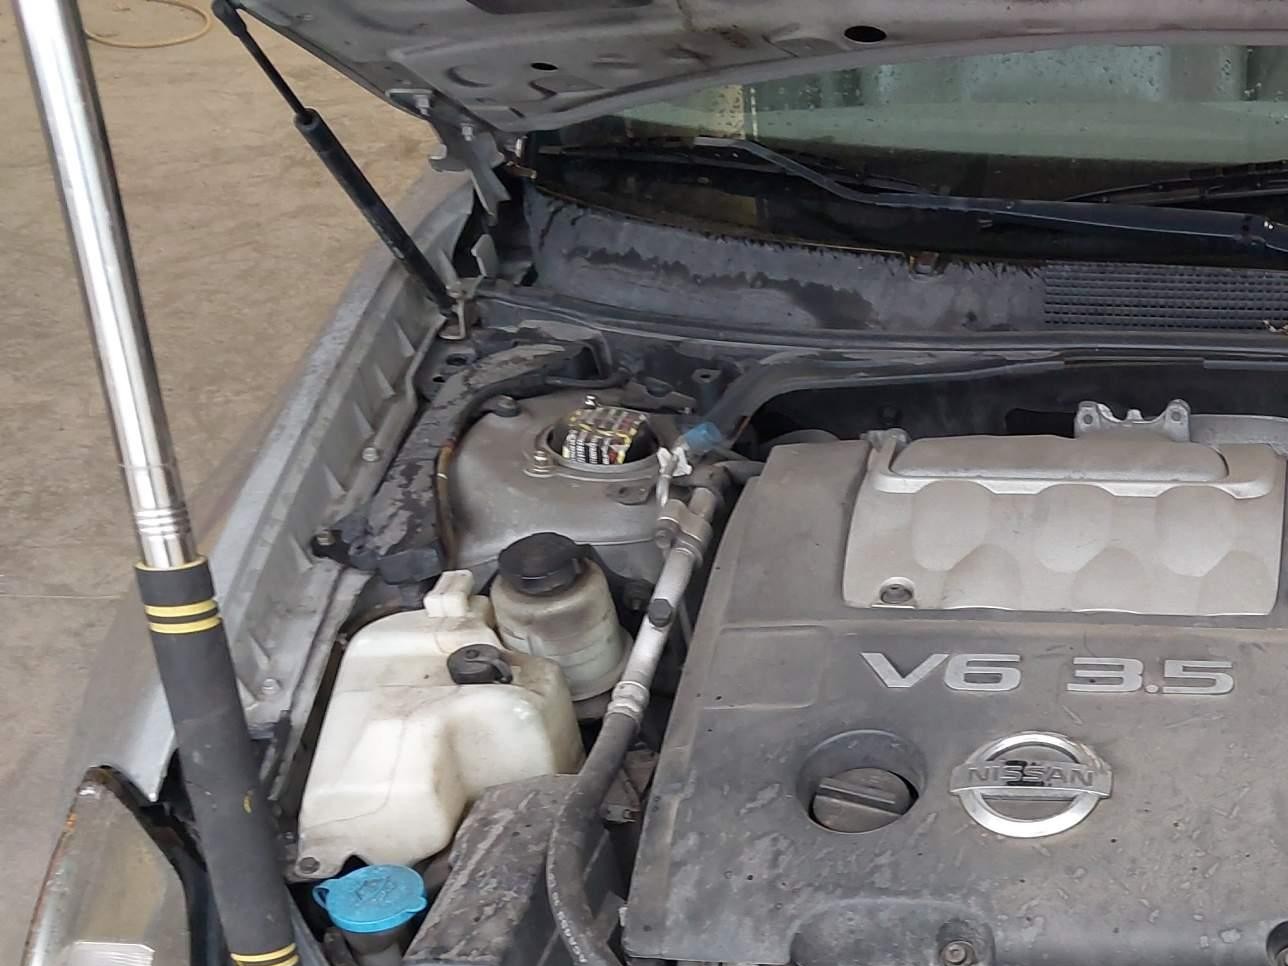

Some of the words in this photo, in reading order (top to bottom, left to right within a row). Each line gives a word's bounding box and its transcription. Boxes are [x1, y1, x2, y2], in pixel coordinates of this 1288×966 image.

[861, 652, 1021, 692] V6
[1066, 656, 1234, 695] 3.5
[967, 766, 1094, 787] NISSAN
